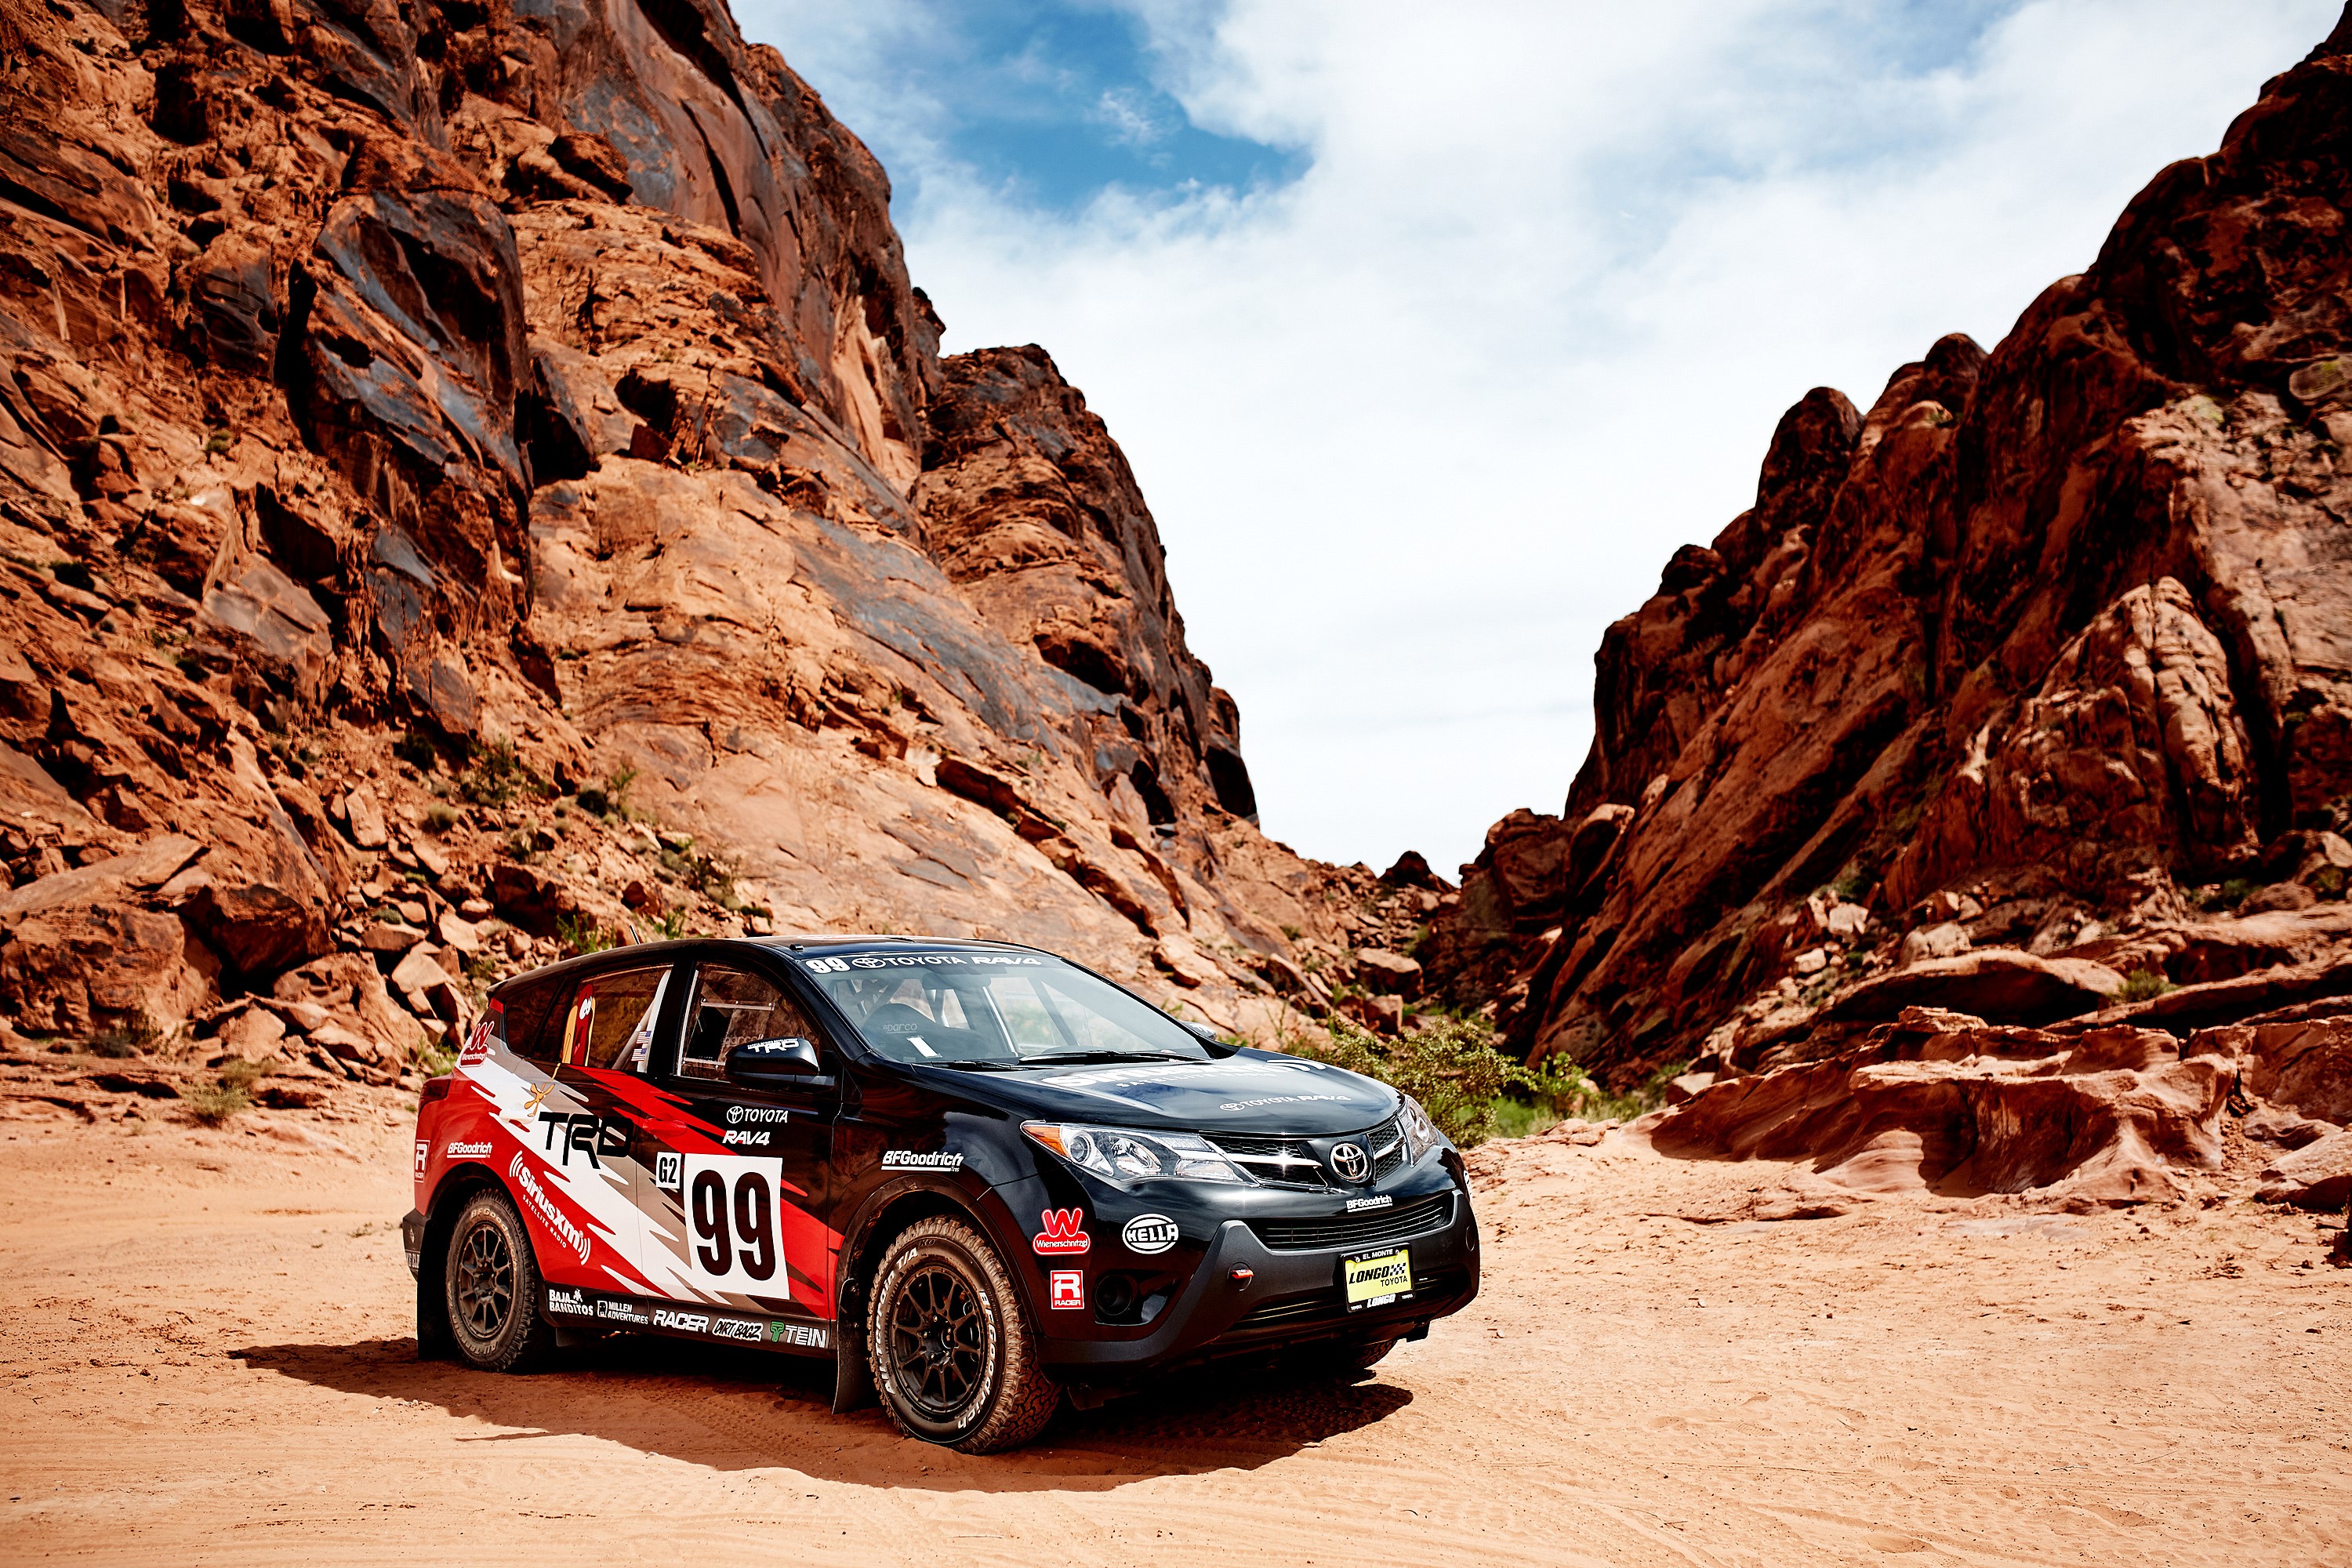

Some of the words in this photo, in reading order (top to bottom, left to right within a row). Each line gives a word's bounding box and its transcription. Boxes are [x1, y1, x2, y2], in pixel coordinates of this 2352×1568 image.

[805, 957, 851, 974] 99
[885, 956, 967, 967] TOYOTA
[971, 956, 1042, 966] RAV4
[747, 1040, 800, 1053] TRD
[1240, 1097, 1300, 1107] TOYOTA
[745, 1109, 789, 1123] TOYOTA
[539, 1112, 633, 1170] TRD
[722, 1130, 770, 1145] RAV4
[447, 1142, 492, 1154] BFGoodrich
[416, 1144, 427, 1171] R
[882, 1150, 964, 1167] BFGoodrich
[659, 1156, 677, 1184] G2
[1346, 1195, 1392, 1209] BFGoodrich
[522, 1194, 549, 1229] SATELLITE
[550, 1225, 567, 1248] RADIO
[691, 1169, 776, 1281] 99
[1041, 1207, 1083, 1238] W
[1126, 1223, 1179, 1243] HELLA
[1036, 1239, 1088, 1248] Wienerschnitzel
[896, 1247, 918, 1269] T/A
[1372, 1249, 1393, 1258] MONTE
[1349, 1265, 1390, 1285] LONGO
[1381, 1276, 1408, 1287] TOYOTA
[1054, 1273, 1081, 1298] R
[549, 1289, 571, 1303] BAJA
[1367, 1294, 1396, 1308] LONGO
[549, 1301, 593, 1316] BANDITOS
[608, 1301, 633, 1313] MILLEN
[608, 1310, 649, 1325] ADVENTURES
[653, 1309, 710, 1333] RACER
[713, 1319, 738, 1337] DIRT
[785, 1324, 826, 1348] TEIN
